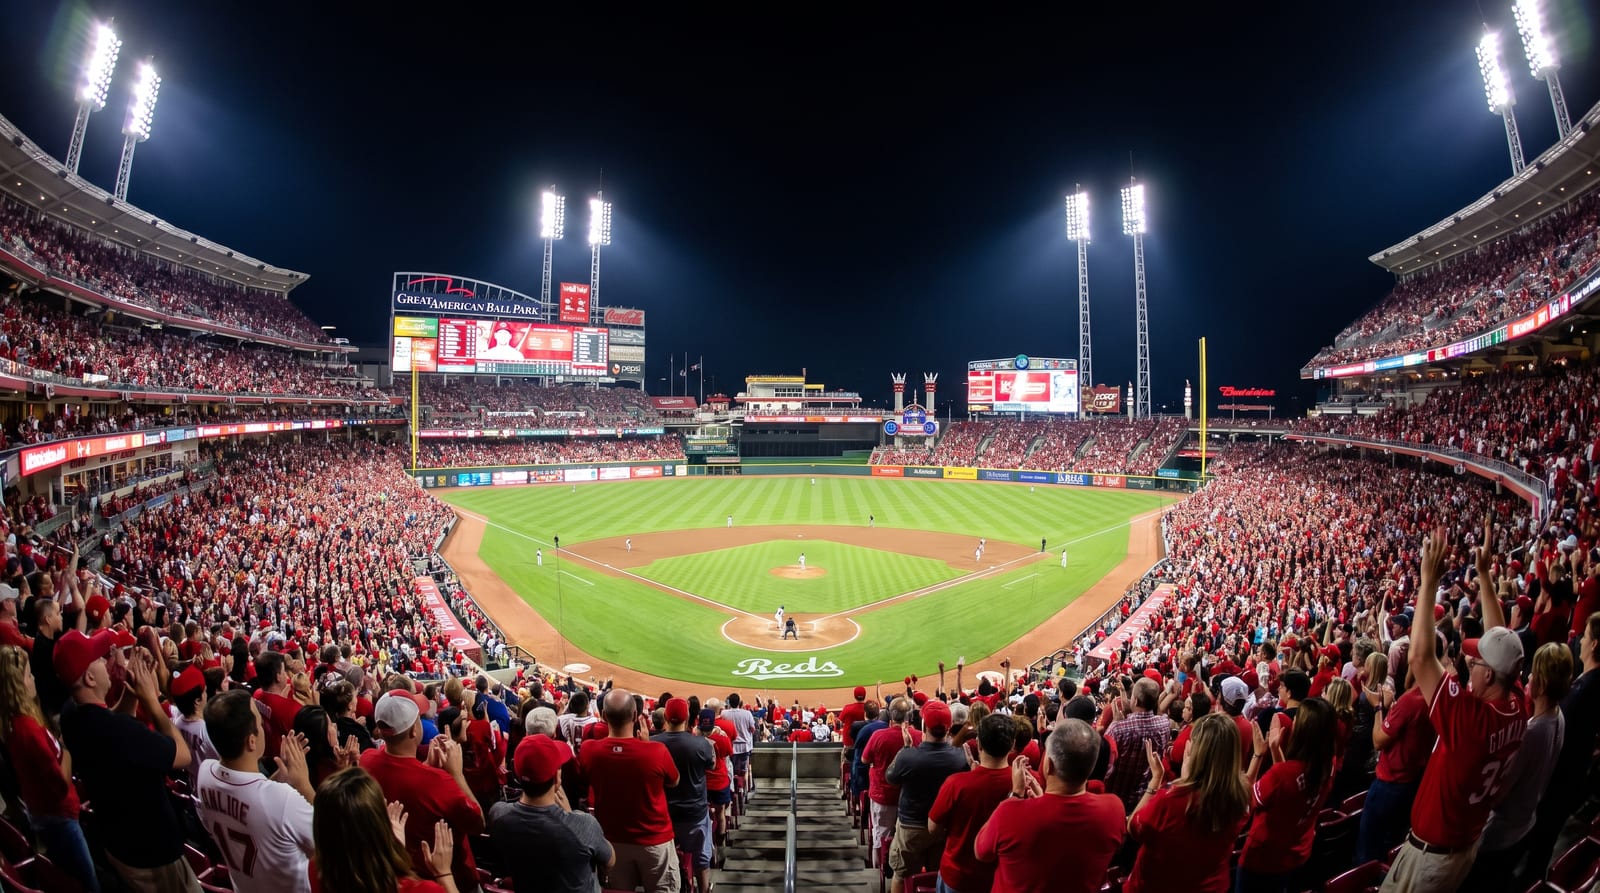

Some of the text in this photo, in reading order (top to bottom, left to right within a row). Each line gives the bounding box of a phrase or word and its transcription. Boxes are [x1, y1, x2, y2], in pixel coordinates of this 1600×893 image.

[486, 302, 512, 314] BALL
[512, 304, 540, 316] PARK
[731, 656, 845, 681] Reds
[213, 820, 258, 879] 17
